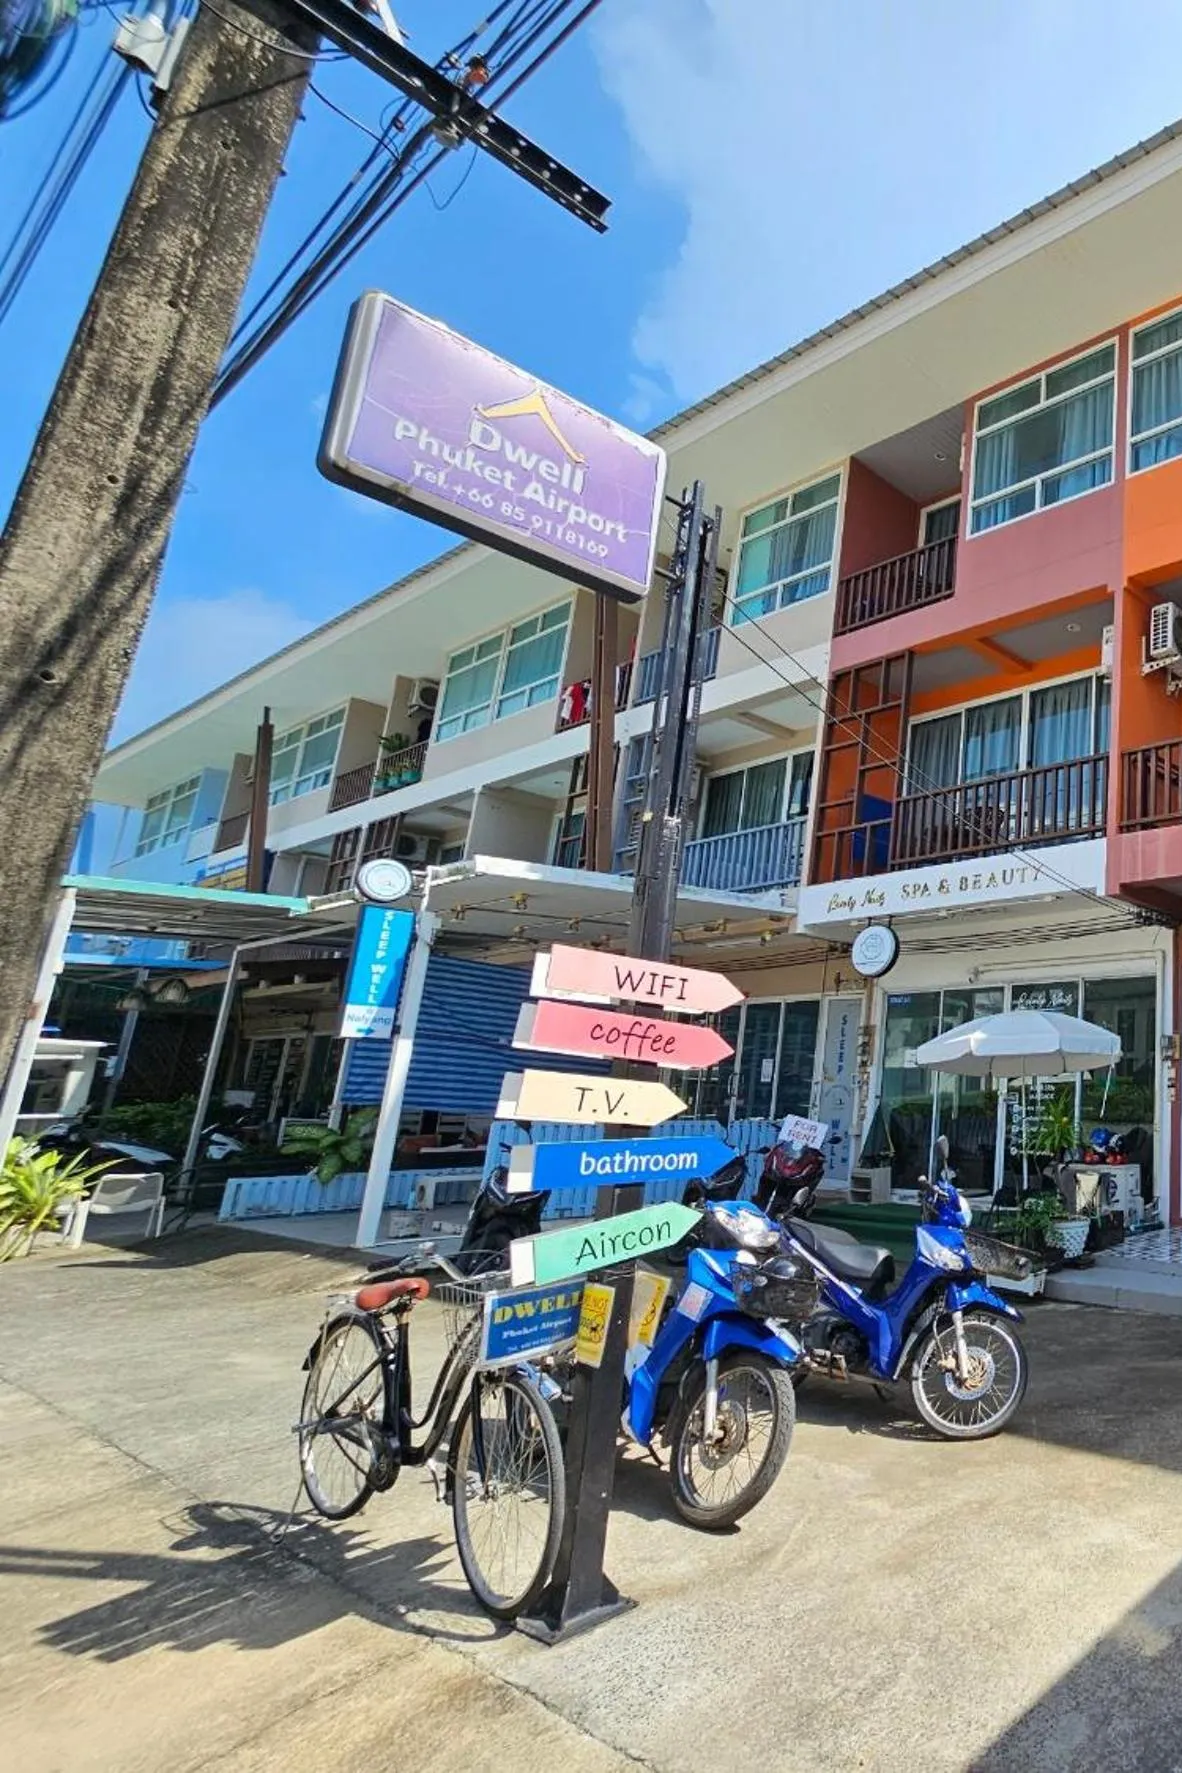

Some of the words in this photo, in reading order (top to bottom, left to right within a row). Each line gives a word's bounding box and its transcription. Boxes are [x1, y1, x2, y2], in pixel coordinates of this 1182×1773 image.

[467, 418, 587, 495] Dwell
[394, 418, 516, 492] Phuket
[523, 477, 627, 543] Airport
[500, 502, 525, 522] 85
[531, 514, 609, 558] 9118169
[901, 882, 931, 900] SPA
[937, 878, 950, 895] &
[959, 863, 1044, 892] BEAUTY
[375, 911, 395, 960] SLEEP
[367, 963, 387, 1004] WELL
[614, 965, 689, 1000] WIFI
[590, 1019, 676, 1057] coffee
[574, 1086, 629, 1117] T.V.
[787, 1129, 817, 1145] RENT
[794, 1119, 818, 1136] FOR
[829, 1118, 841, 1171] WLL
[579, 1149, 698, 1177] bathroom
[574, 1220, 671, 1266] Aircon
[493, 1290, 583, 1325] DWELL
